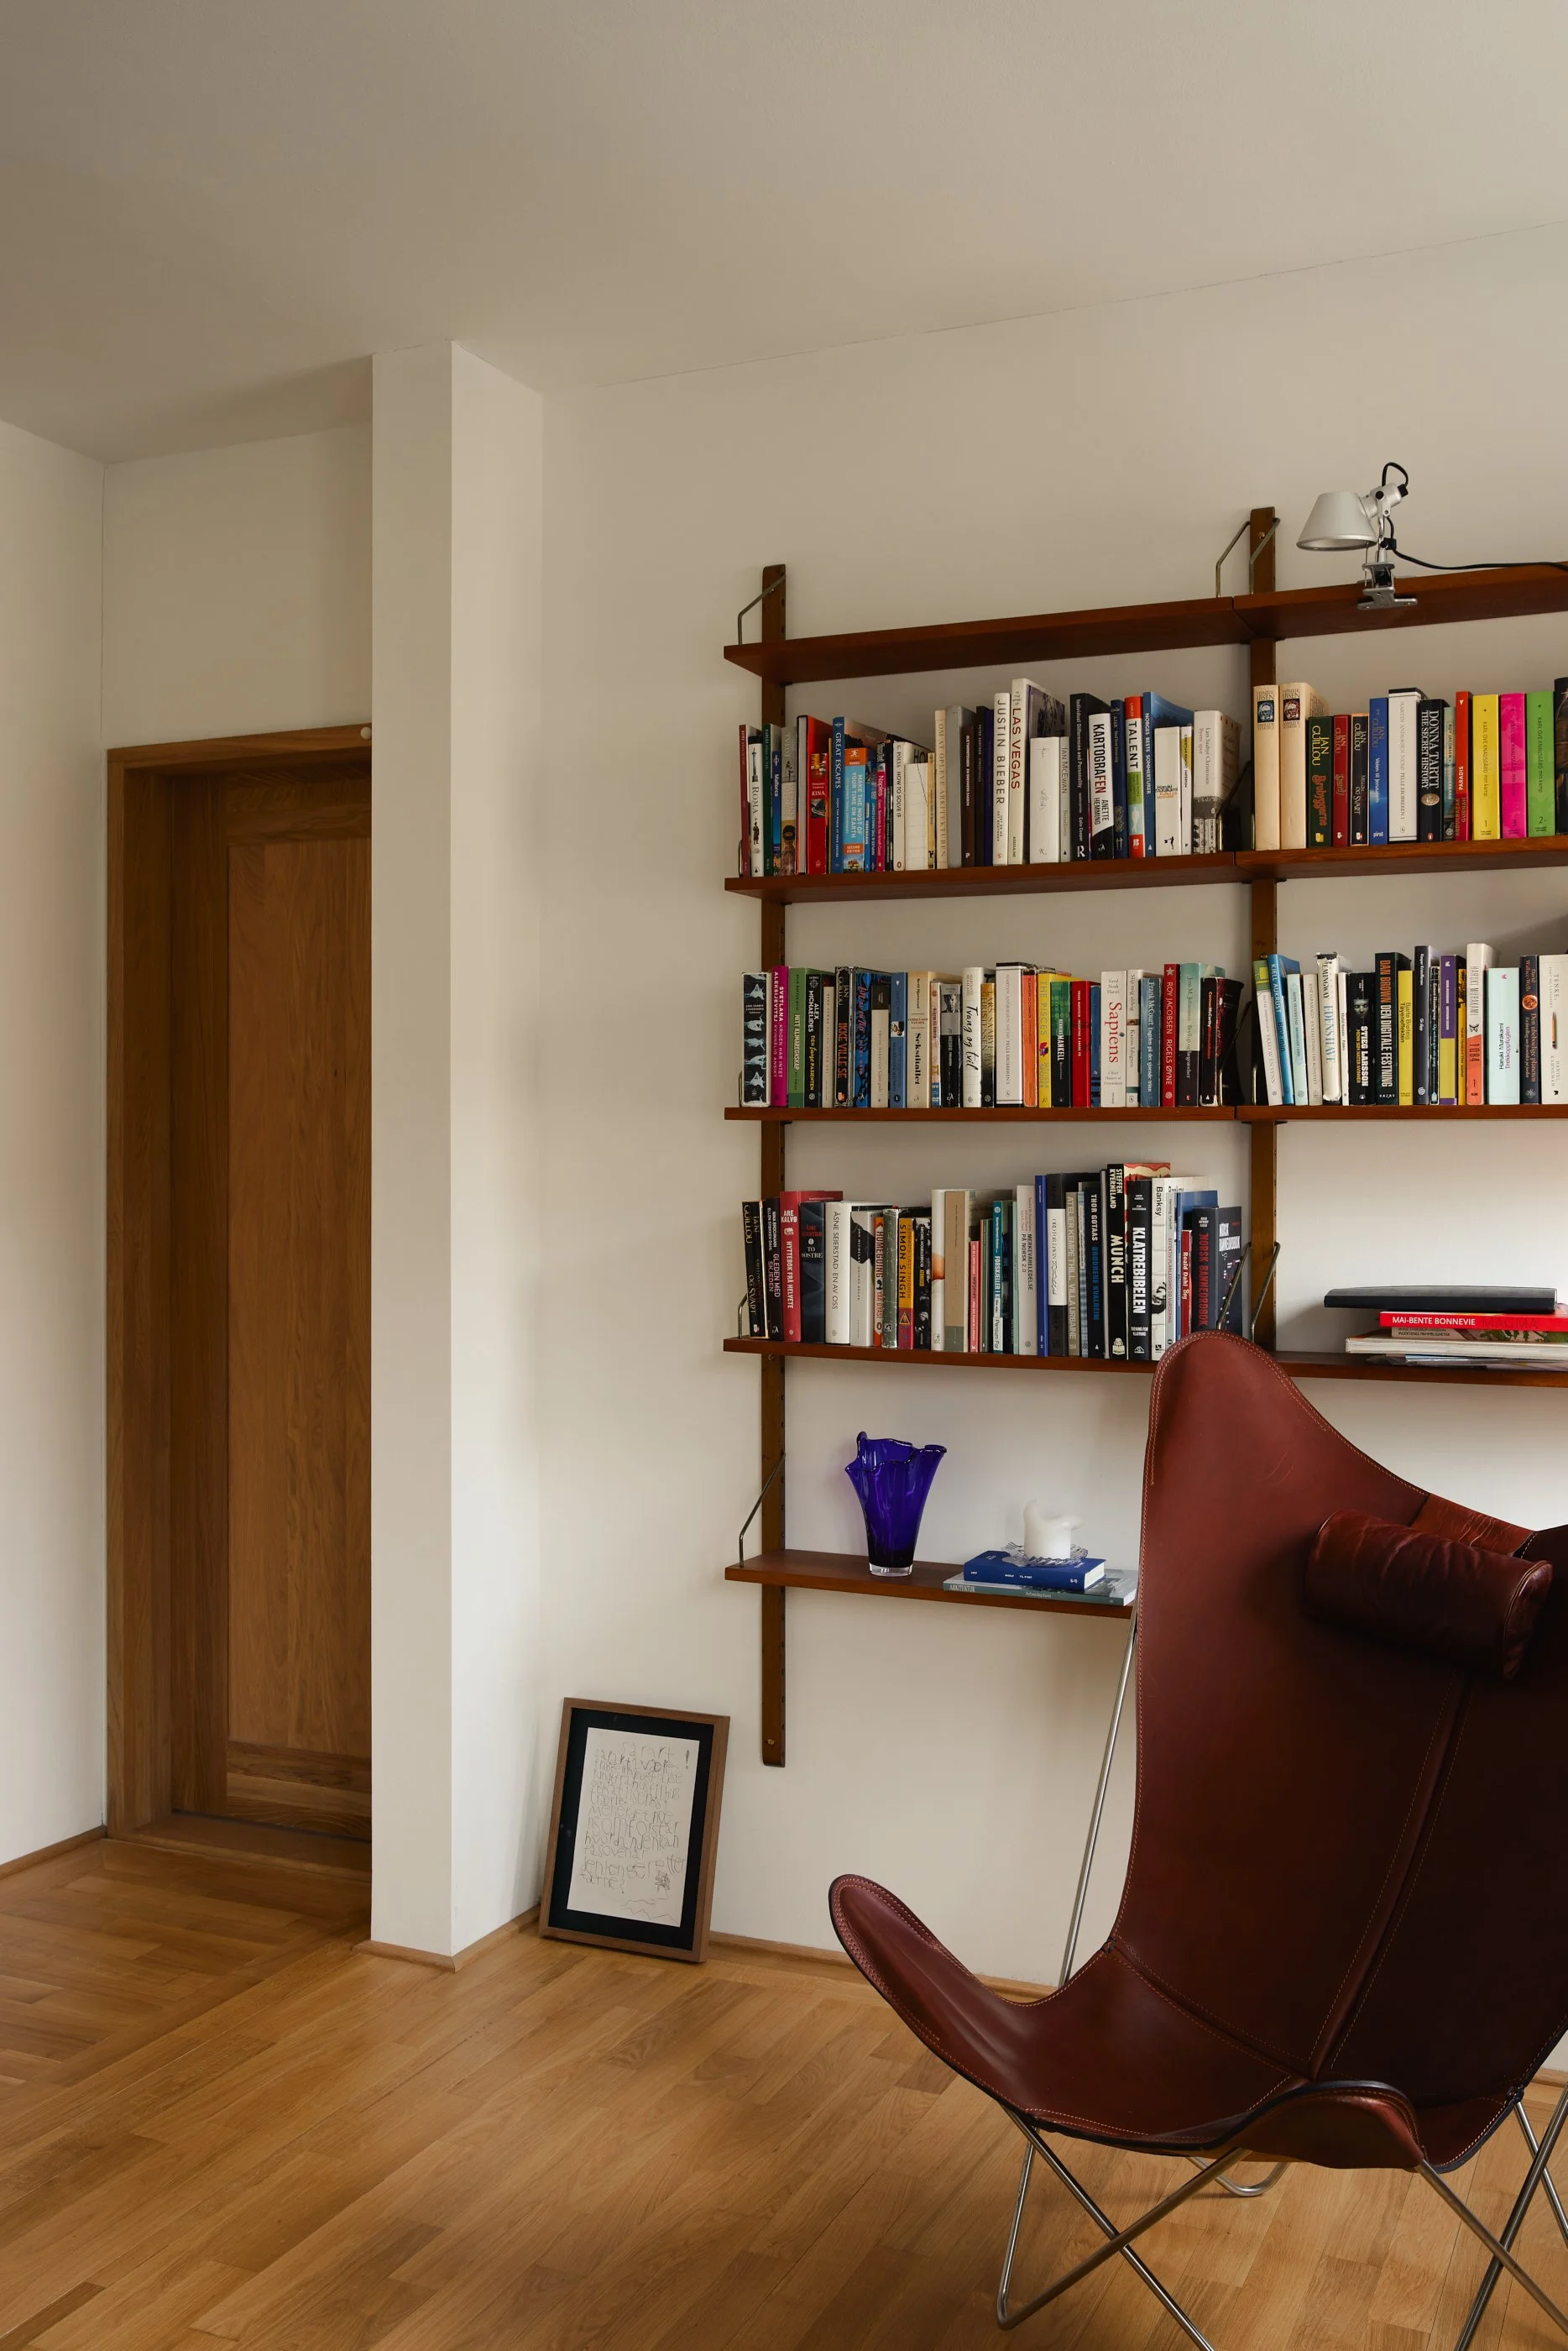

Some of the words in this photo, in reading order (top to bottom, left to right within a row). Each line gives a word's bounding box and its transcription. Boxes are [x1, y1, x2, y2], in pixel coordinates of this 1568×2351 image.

[996, 699, 1006, 747] JUSTIN
[1012, 708, 1022, 735] LAS
[1429, 710, 1440, 749] DONNA
[1128, 721, 1138, 768] TALENT
[1311, 725, 1321, 766] GUILLOU
[1320, 736, 1330, 754] JAN
[1011, 740, 1021, 789] VEGAS
[1093, 724, 1106, 793] KARTOGRAFEN
[1429, 751, 1440, 788] TARTT
[996, 756, 1005, 804] BIEBER
[851, 806, 857, 815] ON
[1312, 775, 1327, 825] Brobyggerne
[1271, 964, 1279, 981] KJELL
[1380, 960, 1391, 975] DAN
[1470, 966, 1478, 985] HARUKI
[1273, 982, 1281, 1013] AUKRUST
[1380, 977, 1391, 1003] BROWN
[1470, 987, 1478, 1016] MURAKAMI
[964, 1005, 979, 1032] Tvang
[1381, 1005, 1392, 1019] DEN
[839, 1022, 847, 1042] IKKE
[963, 1036, 972, 1047] og
[1105, 1002, 1122, 1063] Sapiens
[1381, 1020, 1392, 1051] DIGITALE
[838, 1043, 847, 1067] VILLE
[965, 1051, 979, 1071] tvil
[1470, 1044, 1480, 1062] 1Q84
[838, 1068, 847, 1078] SE
[1381, 1052, 1393, 1087] FESTNING
[744, 1204, 752, 1244] GUILLOU
[833, 1212, 841, 1231] ÅSNE
[1111, 1234, 1124, 1283] MUNCH
[1200, 1234, 1209, 1262] NORSK
[748, 1275, 754, 1285] OG
[832, 1272, 839, 1283] EN
[1133, 1227, 1146, 1313] KLATREBIBELEN
[748, 1287, 756, 1315] SVART
[832, 1284, 839, 1294] AV
[1199, 1265, 1209, 1327] BANNEORDBOK
[1393, 1317, 1433, 1325] MAI-BENTE
[1435, 1317, 1476, 1326] BONNEVIE
[1482, 1317, 1538, 1329] MAGMA
[949, 1584, 975, 1593] ARKITEKTUR
